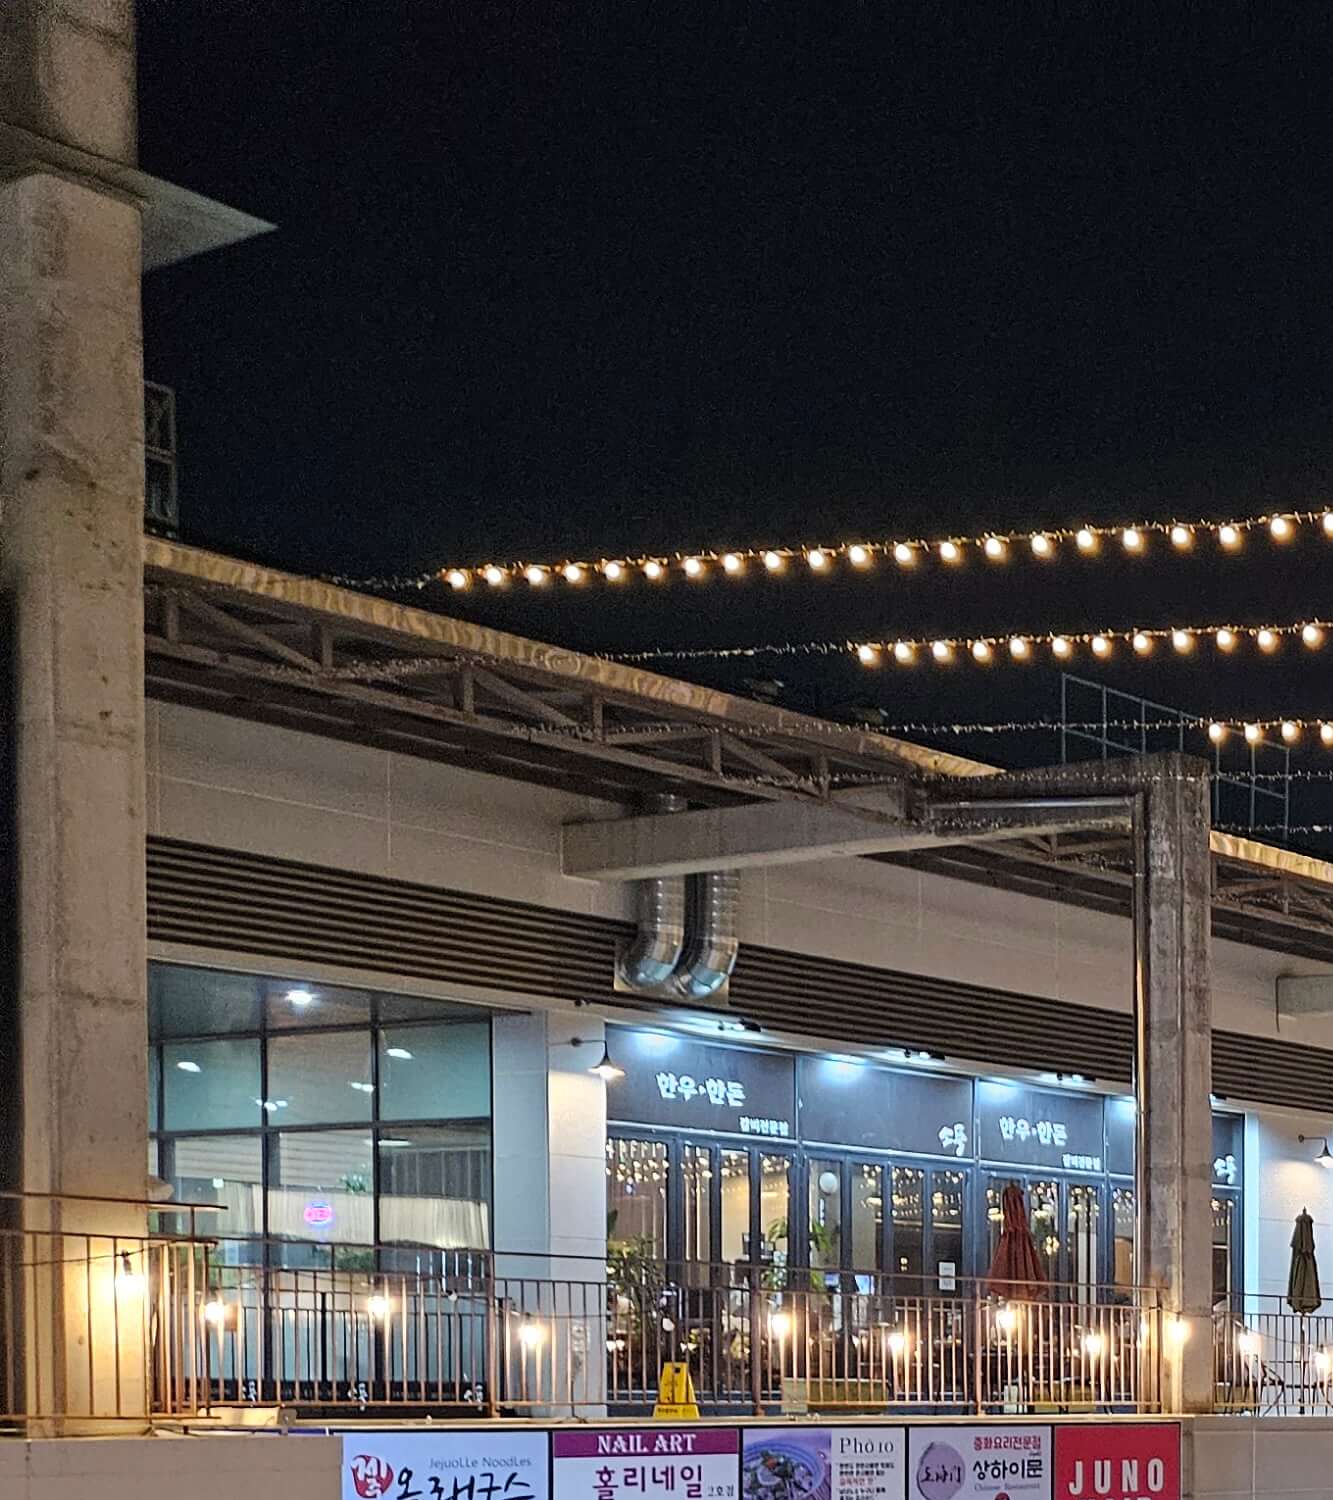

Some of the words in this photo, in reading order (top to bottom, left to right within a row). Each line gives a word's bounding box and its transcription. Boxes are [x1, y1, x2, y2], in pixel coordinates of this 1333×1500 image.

[598, 1435, 648, 1454] NAIL
[654, 1434, 697, 1453] ART
[973, 1459, 1043, 1480] 상하이문
[1068, 1458, 1164, 1495] JUNO
